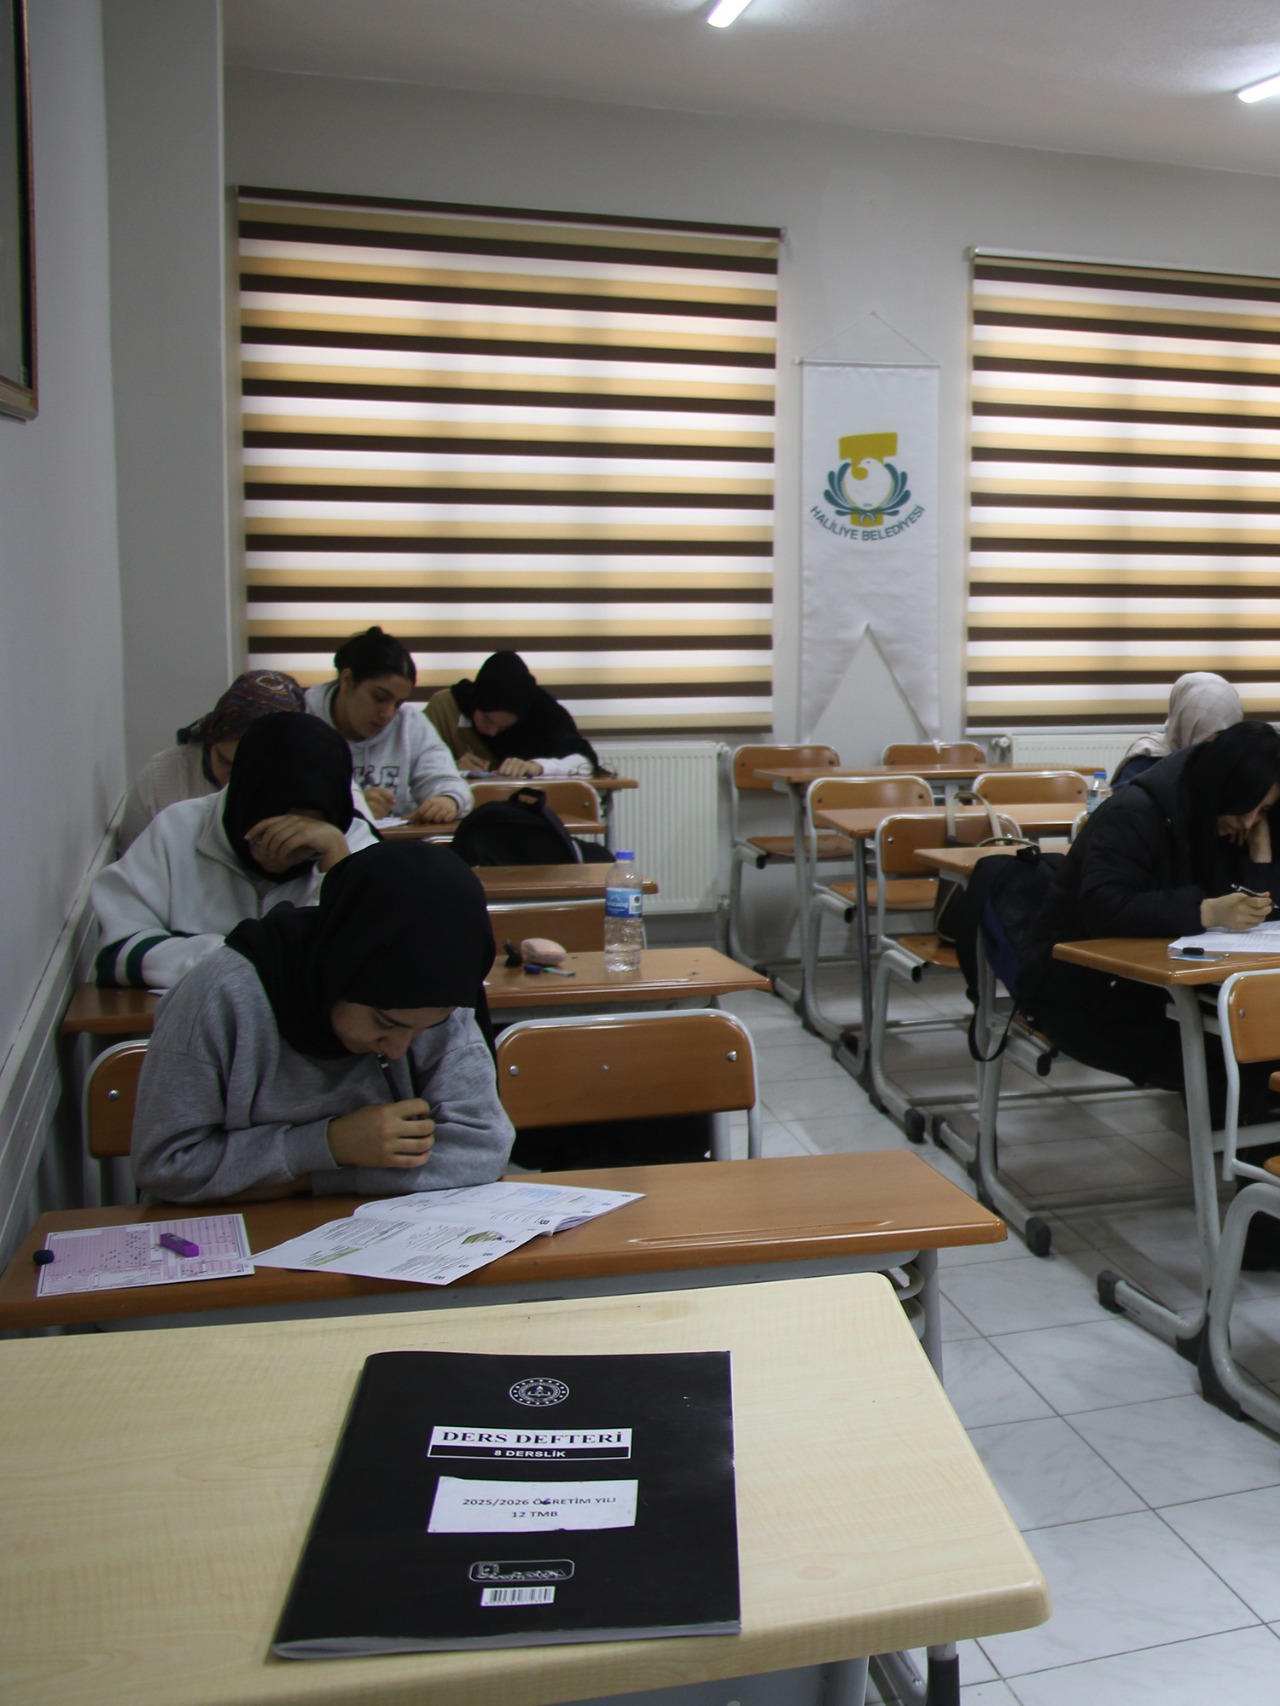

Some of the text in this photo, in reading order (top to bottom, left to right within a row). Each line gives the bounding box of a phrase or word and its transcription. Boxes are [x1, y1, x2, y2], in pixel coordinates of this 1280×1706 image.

[809, 503, 926, 541] HALİLİYE BELEDİYESİ
[442, 1431, 624, 1444] DERS DEFTERİ
[505, 1449, 567, 1458] DERSLİK
[462, 1498, 530, 1507] 2025/2026
